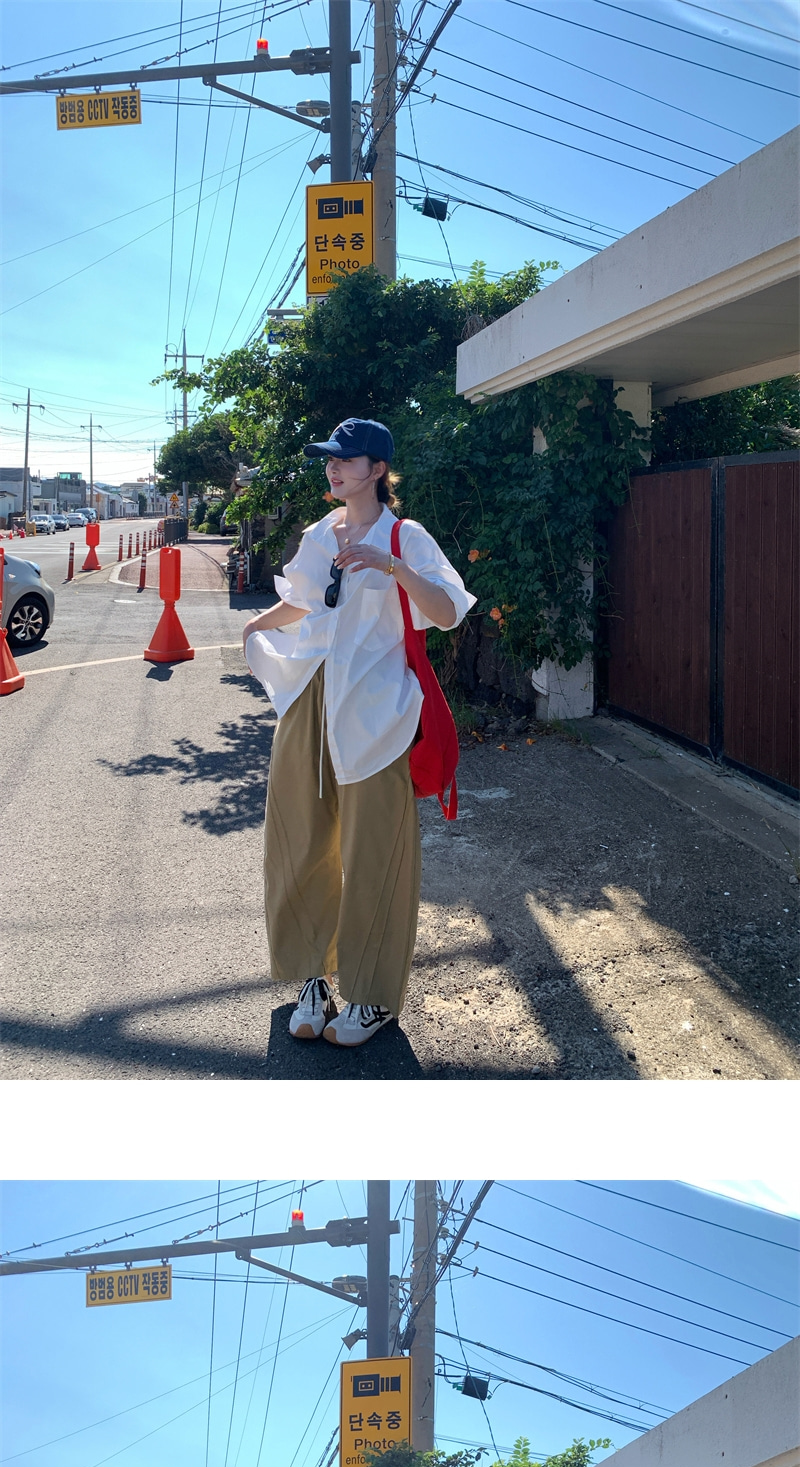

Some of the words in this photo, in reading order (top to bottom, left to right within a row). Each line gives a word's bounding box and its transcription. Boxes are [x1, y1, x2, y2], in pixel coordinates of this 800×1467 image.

[60, 99, 85, 125] 방범용
[88, 98, 109, 121] CCTV
[112, 95, 137, 120] 작동중
[314, 232, 365, 252] 단속중
[320, 258, 360, 270] Photo
[89, 1276, 114, 1301] 방범용
[117, 1274, 139, 1297] CCTV
[142, 1271, 168, 1295] 작동중
[348, 1411, 402, 1431] 단속중
[354, 1438, 396, 1450] Photo
